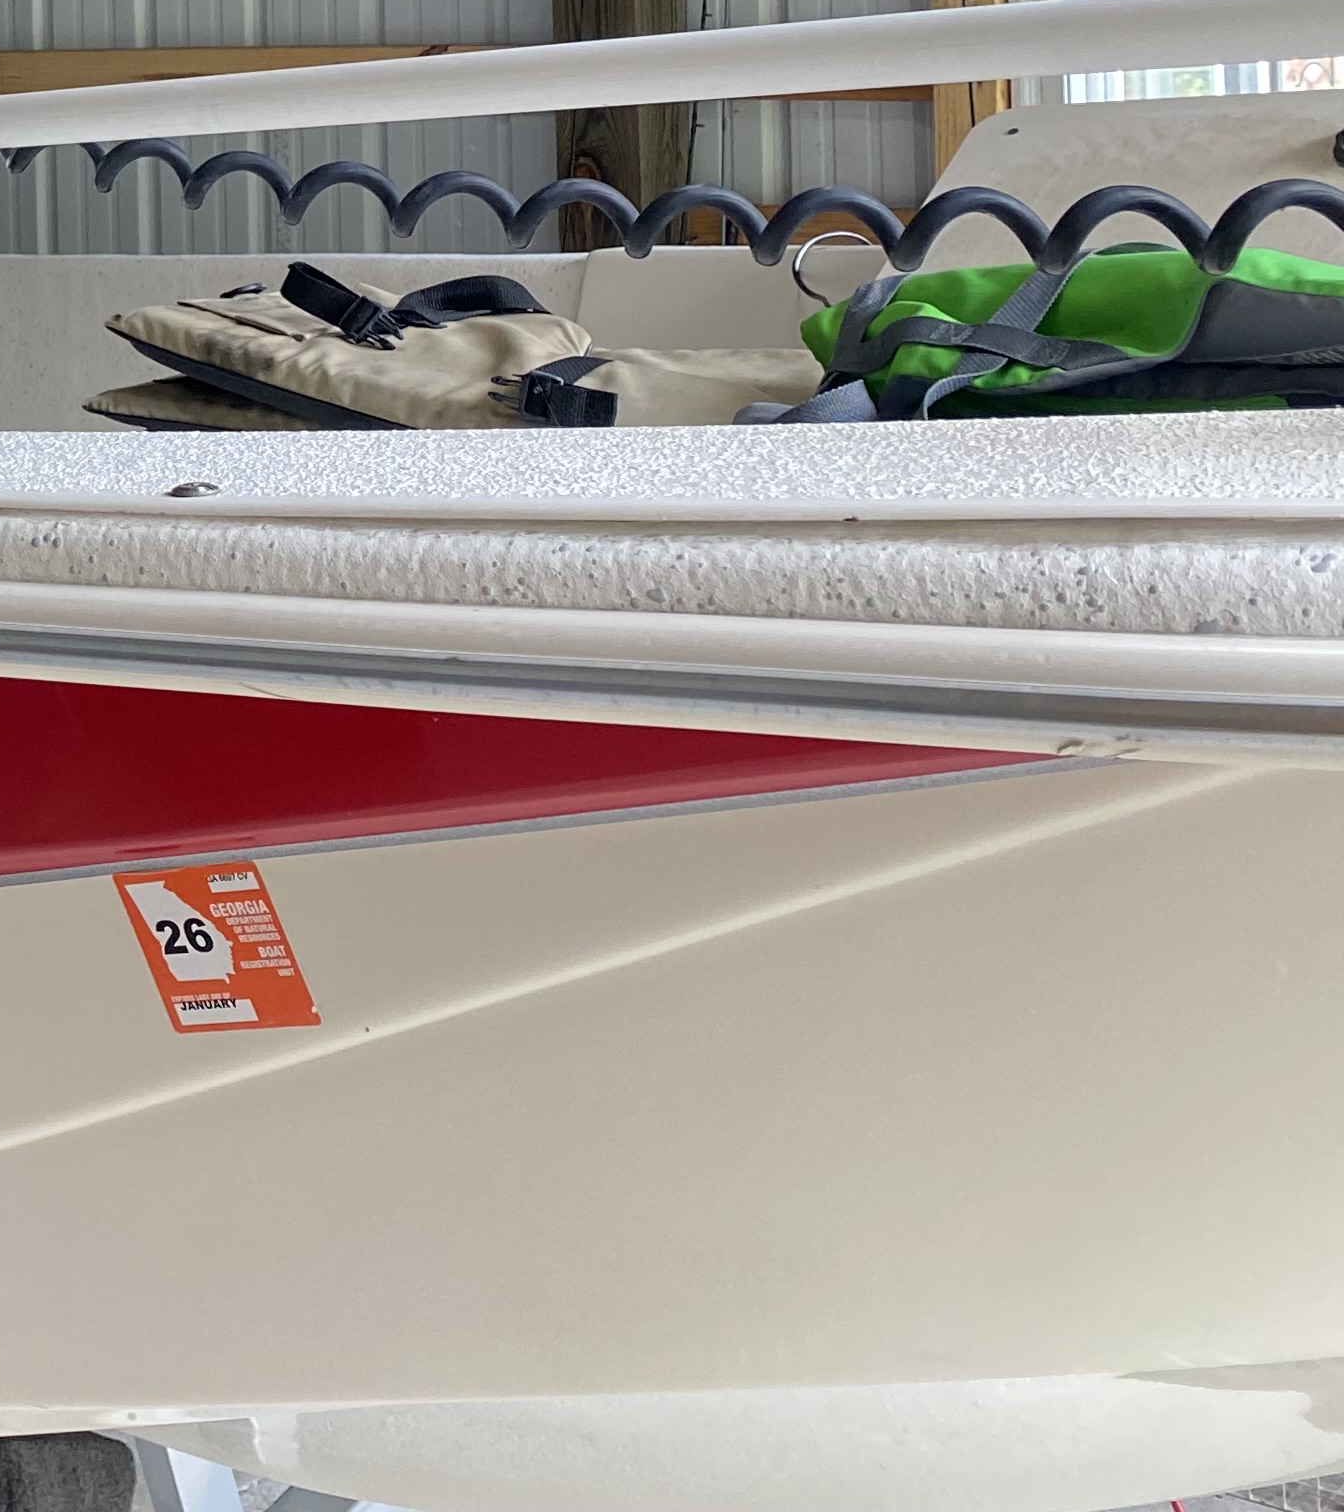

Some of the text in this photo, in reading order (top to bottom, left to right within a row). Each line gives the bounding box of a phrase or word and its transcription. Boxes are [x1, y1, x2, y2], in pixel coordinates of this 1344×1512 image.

[209, 899, 271, 918] GEORGIA
[155, 918, 214, 955] 26
[257, 945, 287, 958] BOAT
[181, 998, 237, 1011] JANUARY
